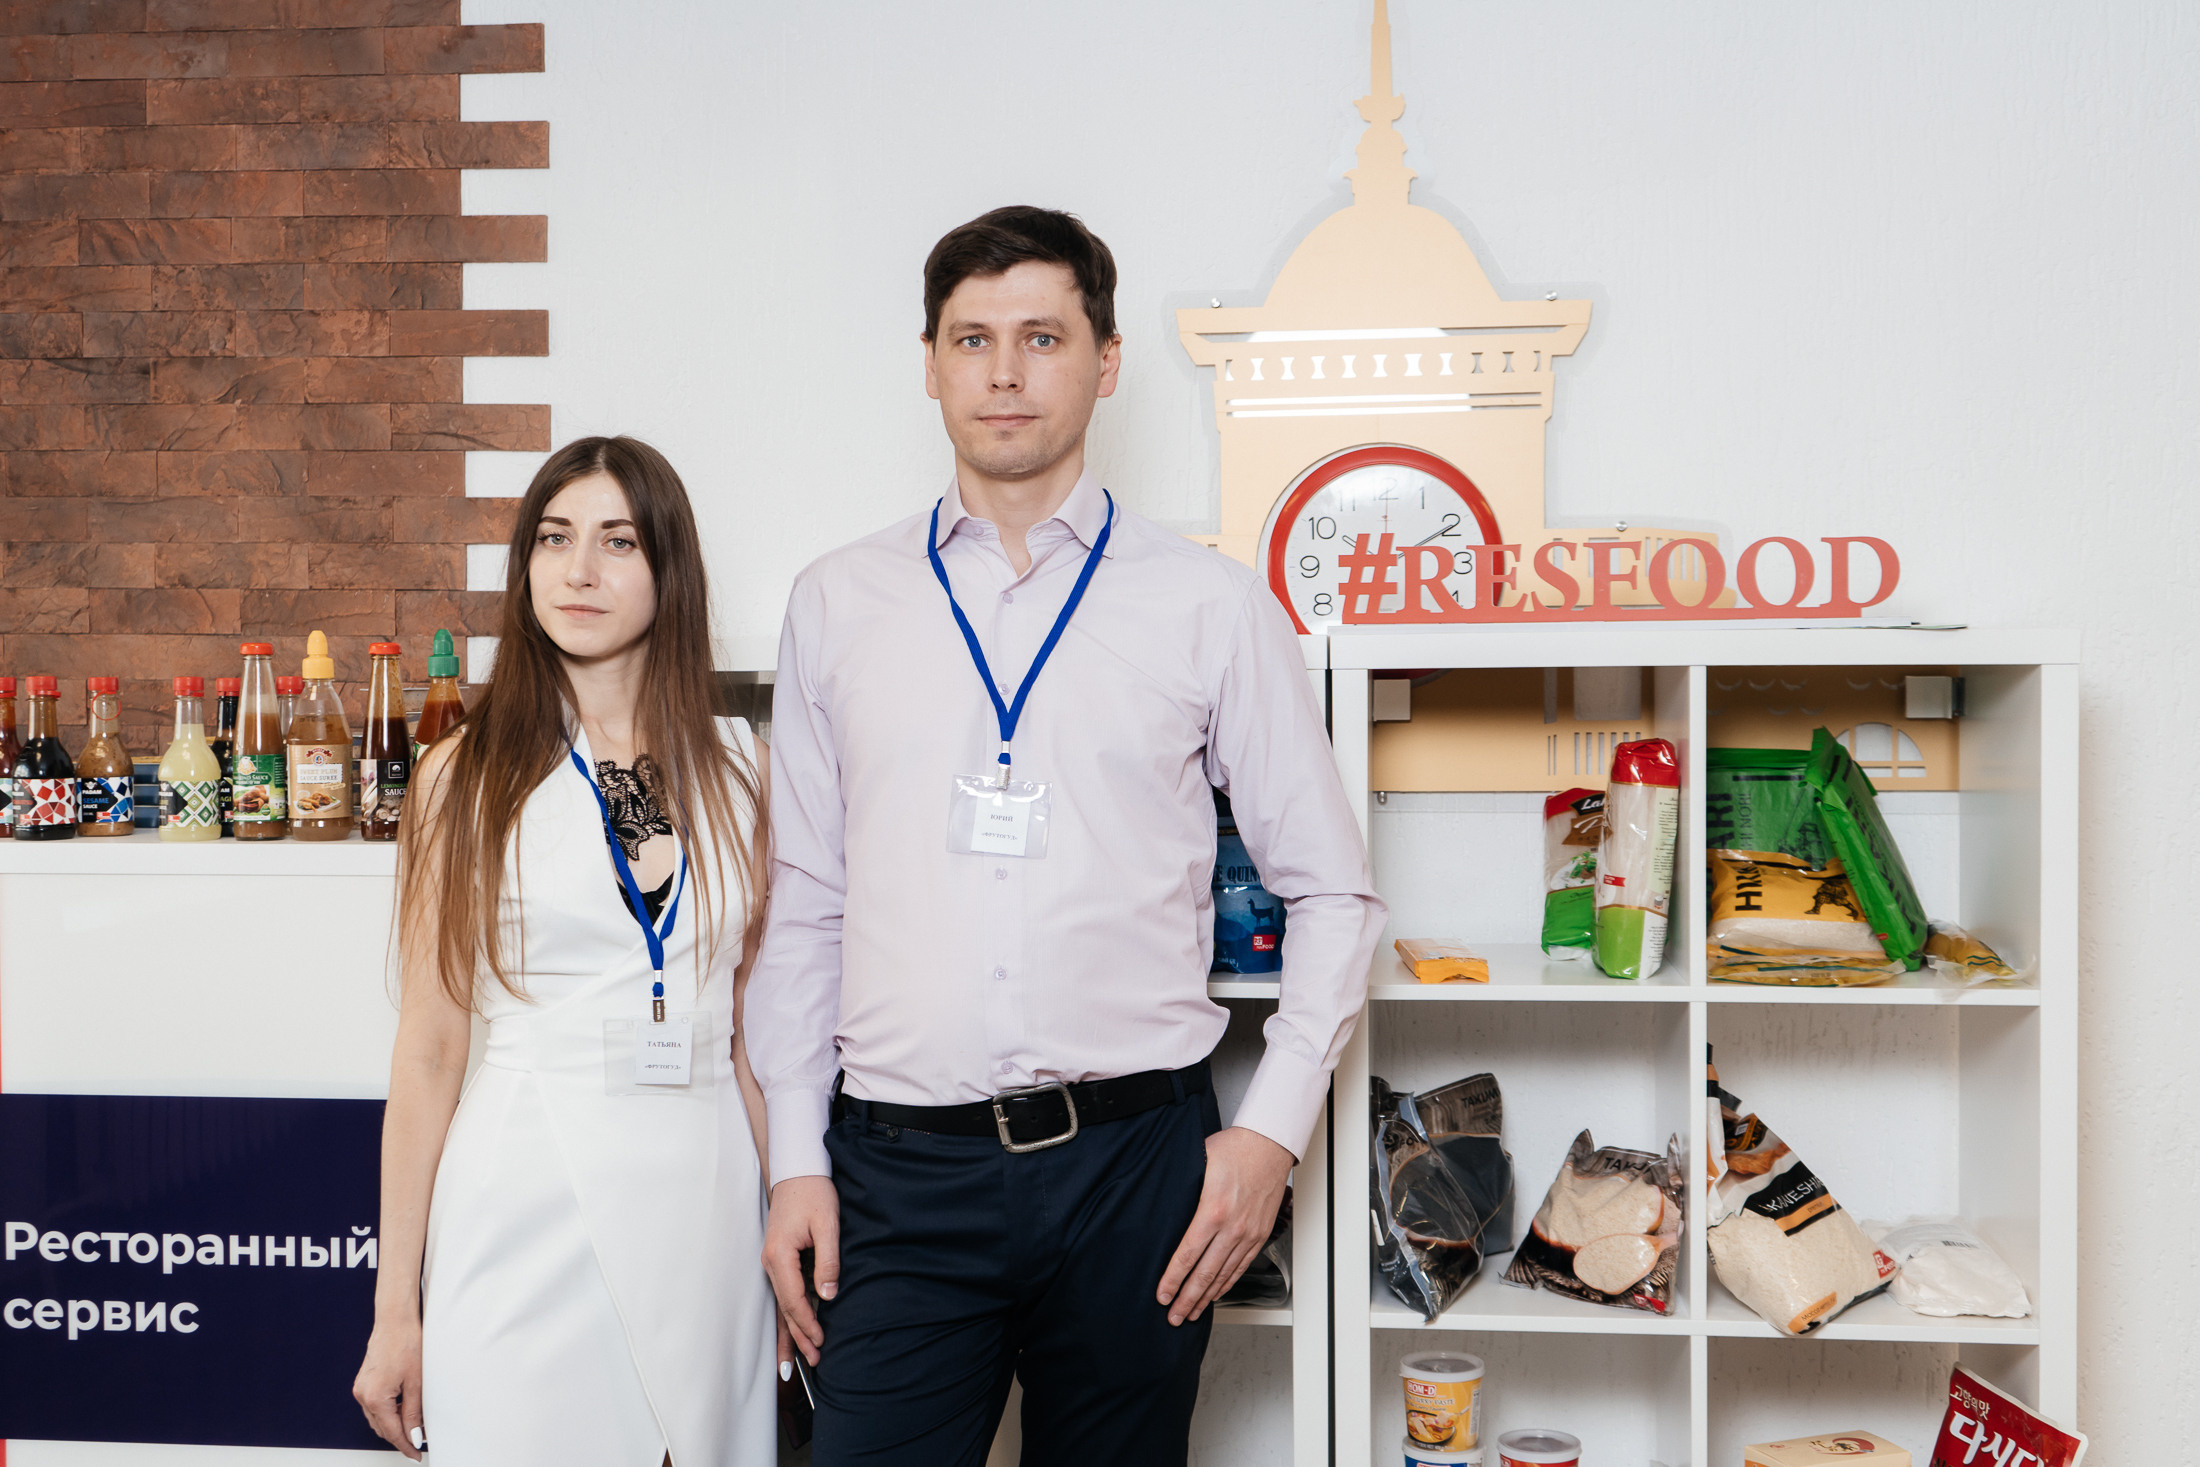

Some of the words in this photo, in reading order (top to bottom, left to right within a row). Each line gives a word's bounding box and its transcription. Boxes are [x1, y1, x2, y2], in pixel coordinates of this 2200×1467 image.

[1373, 477, 1399, 501] 2
[1418, 486, 1425, 509] 1
[1308, 516, 1337, 540] 10
[1441, 513, 1461, 537] 2
[1300, 555, 1320, 578] 9
[1453, 551, 1473, 574] 3
[1338, 532, 1900, 618] #RESFOOD
[1313, 592, 1333, 616] 8
[990, 814, 1014, 822] ЮРИЙ
[1226, 865, 1261, 883] QUIN
[647, 1040, 682, 1049] ТАТЬЯНА
[4, 1221, 378, 1275] Ресторанный
[3, 1296, 200, 1340] сервис
